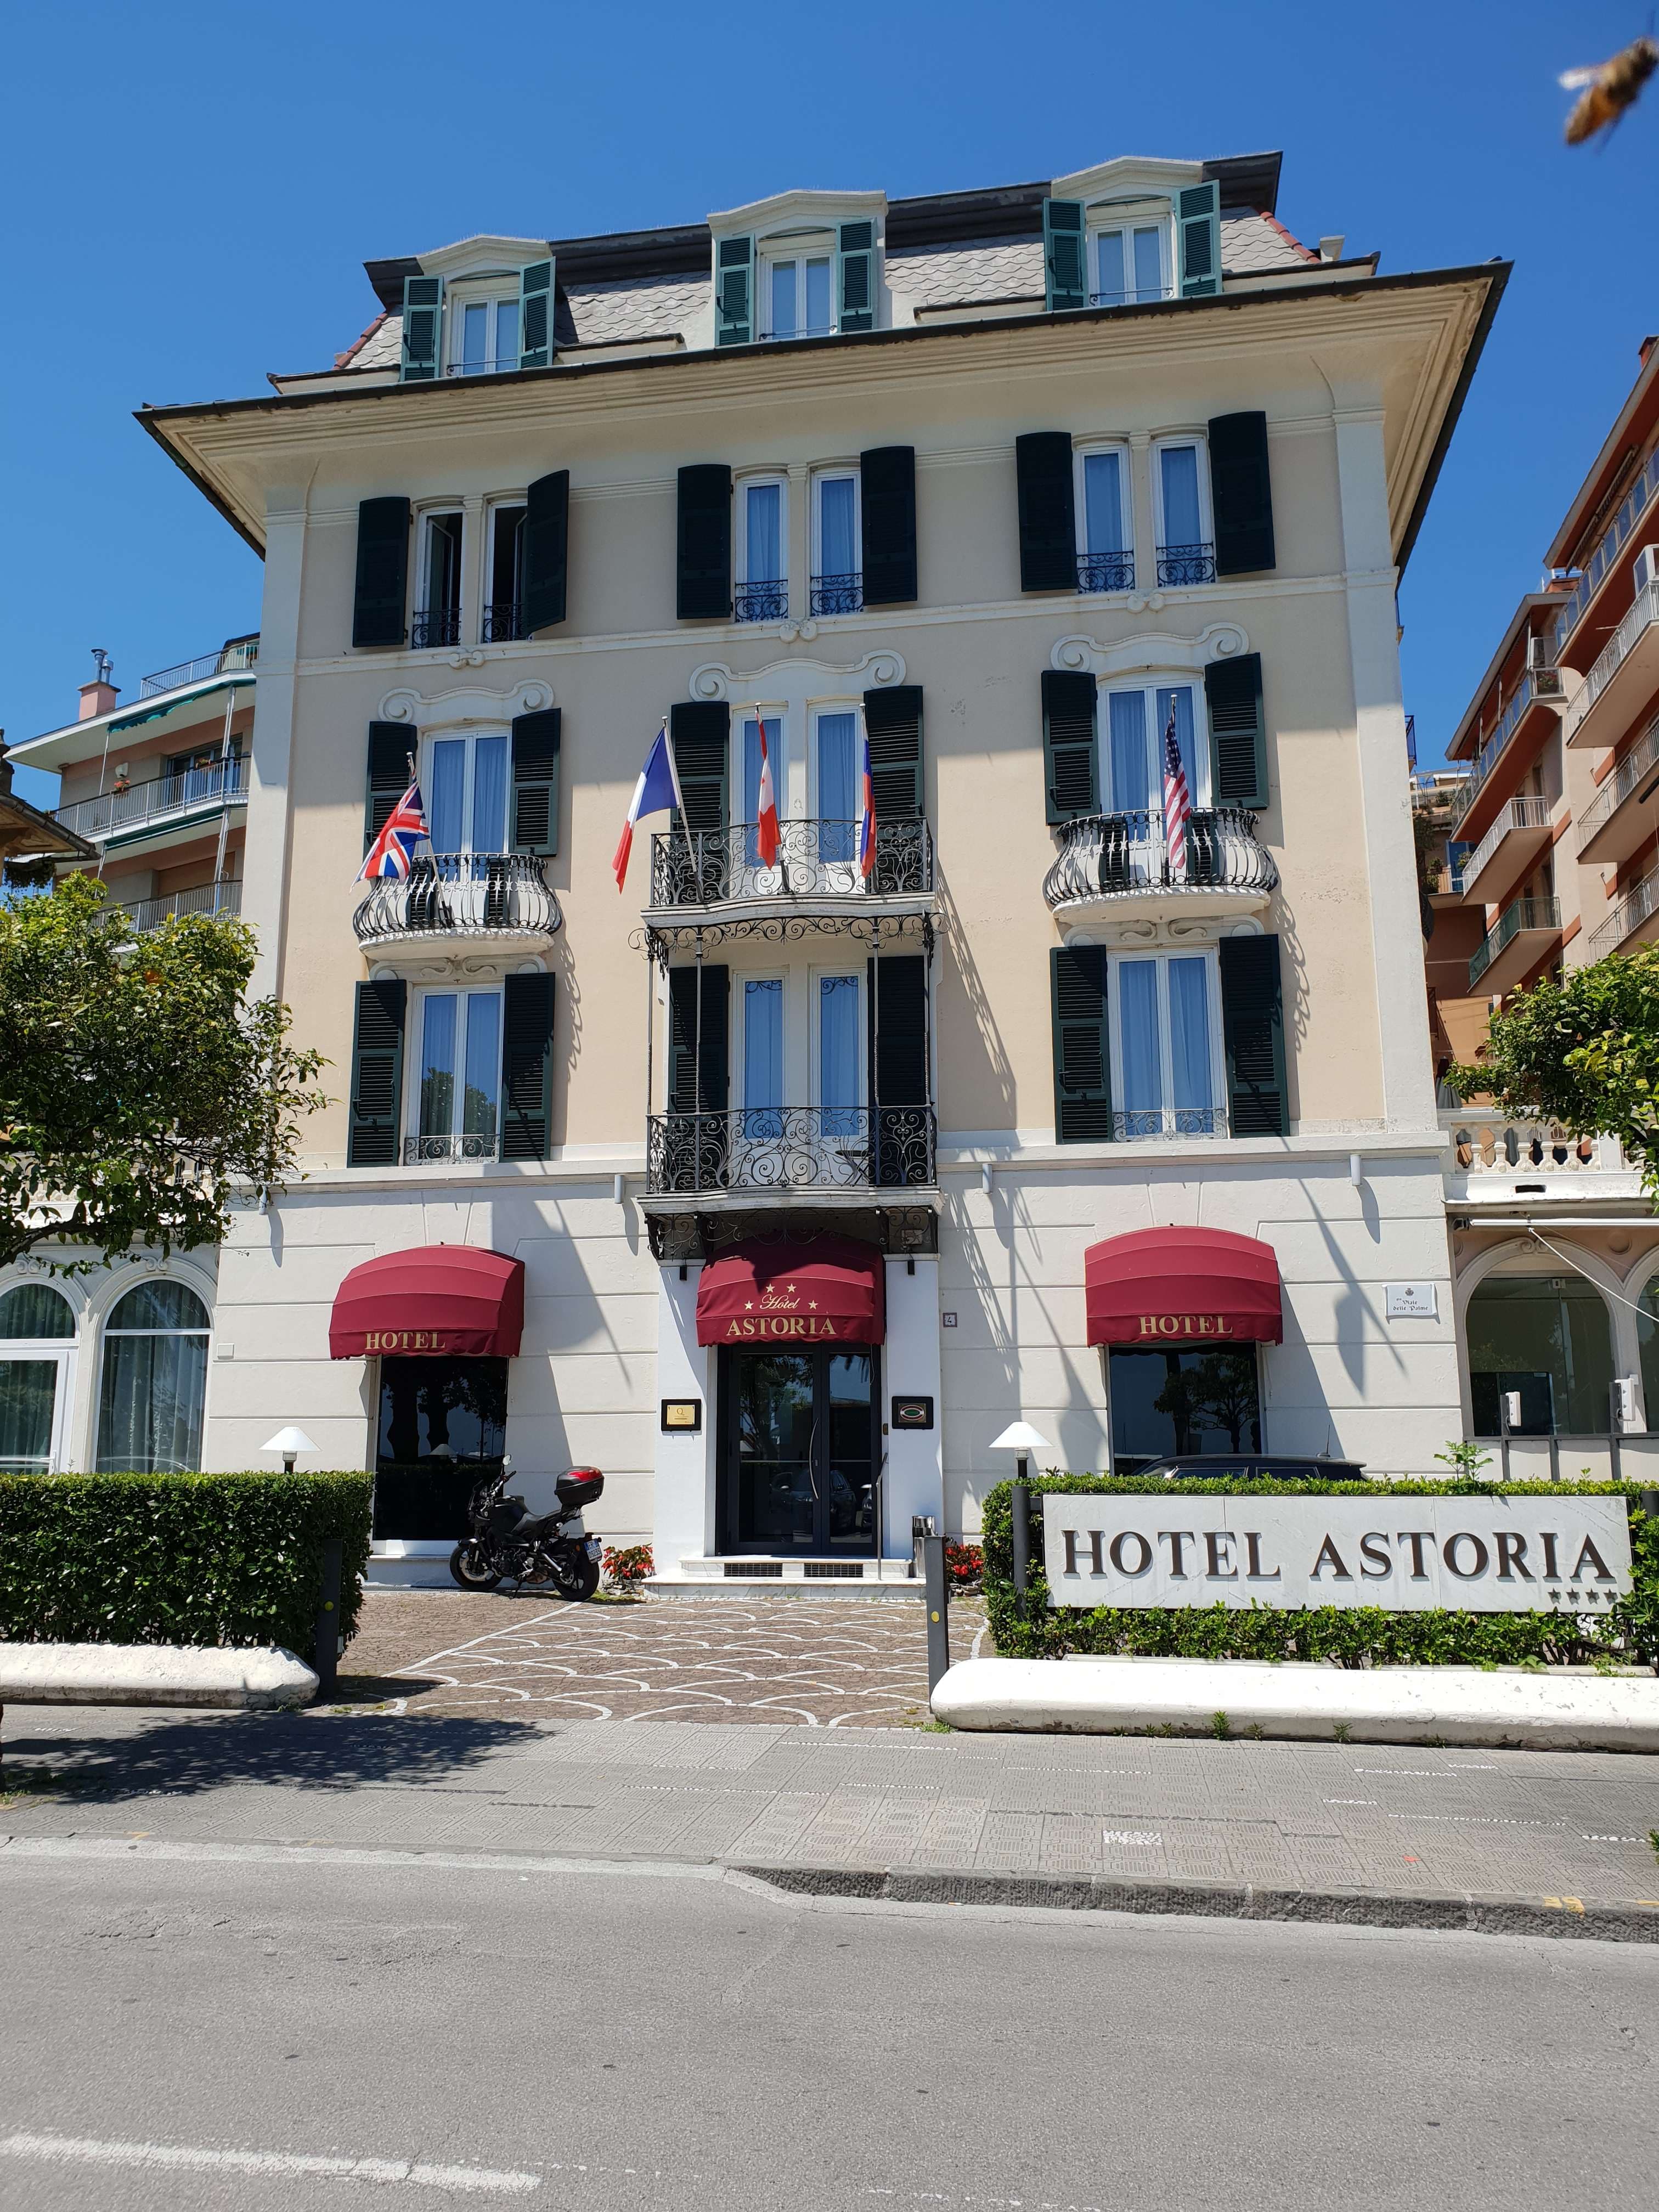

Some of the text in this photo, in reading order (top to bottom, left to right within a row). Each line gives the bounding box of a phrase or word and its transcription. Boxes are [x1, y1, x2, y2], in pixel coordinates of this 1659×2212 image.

[759, 1294, 800, 1309] Hotel
[726, 1317, 837, 1336] ASTORIA
[1138, 1316, 1233, 1334] HOTEL
[364, 1331, 445, 1350] HOTEL
[1062, 1530, 1616, 1580] HOTEL ASTORIA
